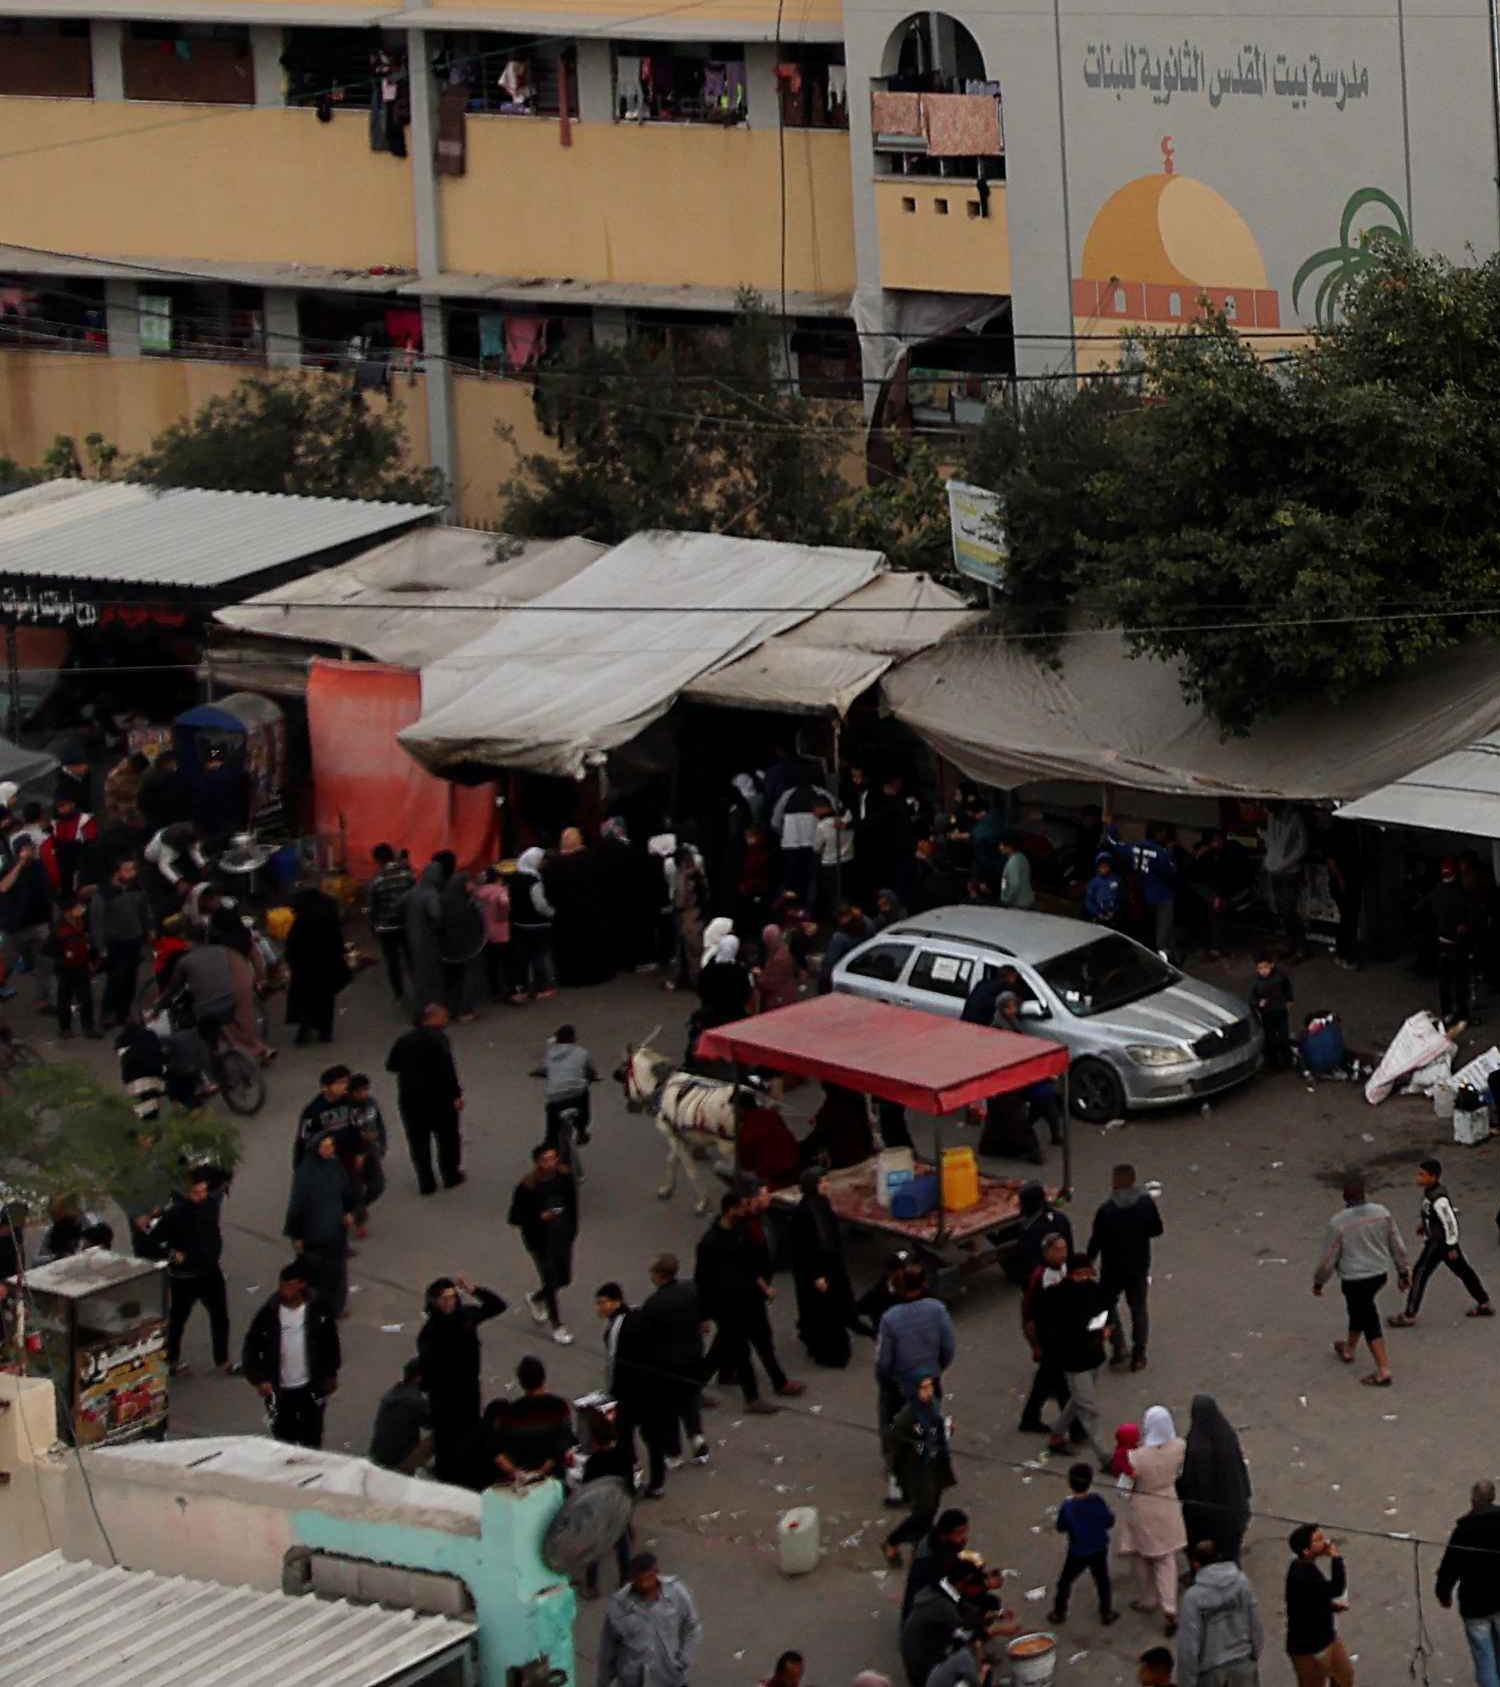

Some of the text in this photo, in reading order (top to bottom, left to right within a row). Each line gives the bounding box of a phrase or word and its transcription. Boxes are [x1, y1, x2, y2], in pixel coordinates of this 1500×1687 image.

[1084, 40, 1369, 111] مدرسة بيت المقدس الثانوية للبنات
